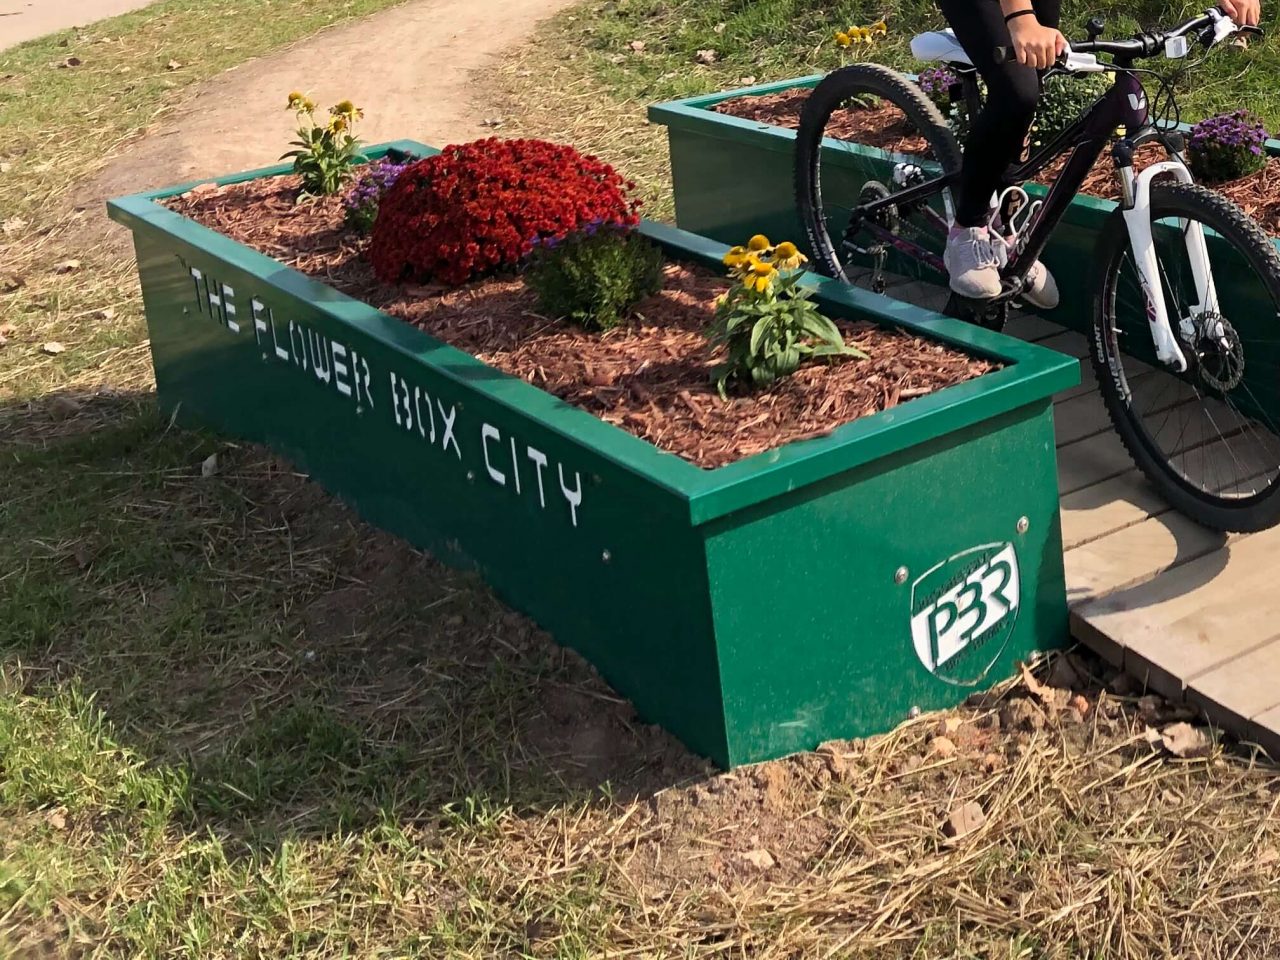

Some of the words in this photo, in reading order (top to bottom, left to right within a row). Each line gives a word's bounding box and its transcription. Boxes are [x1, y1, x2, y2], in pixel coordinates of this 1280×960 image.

[190, 267, 240, 333] THE
[251, 297, 374, 409] FLOWER
[390, 371, 462, 461] BOX
[481, 422, 582, 527] CITY
[1094, 324, 1105, 364] GIANT
